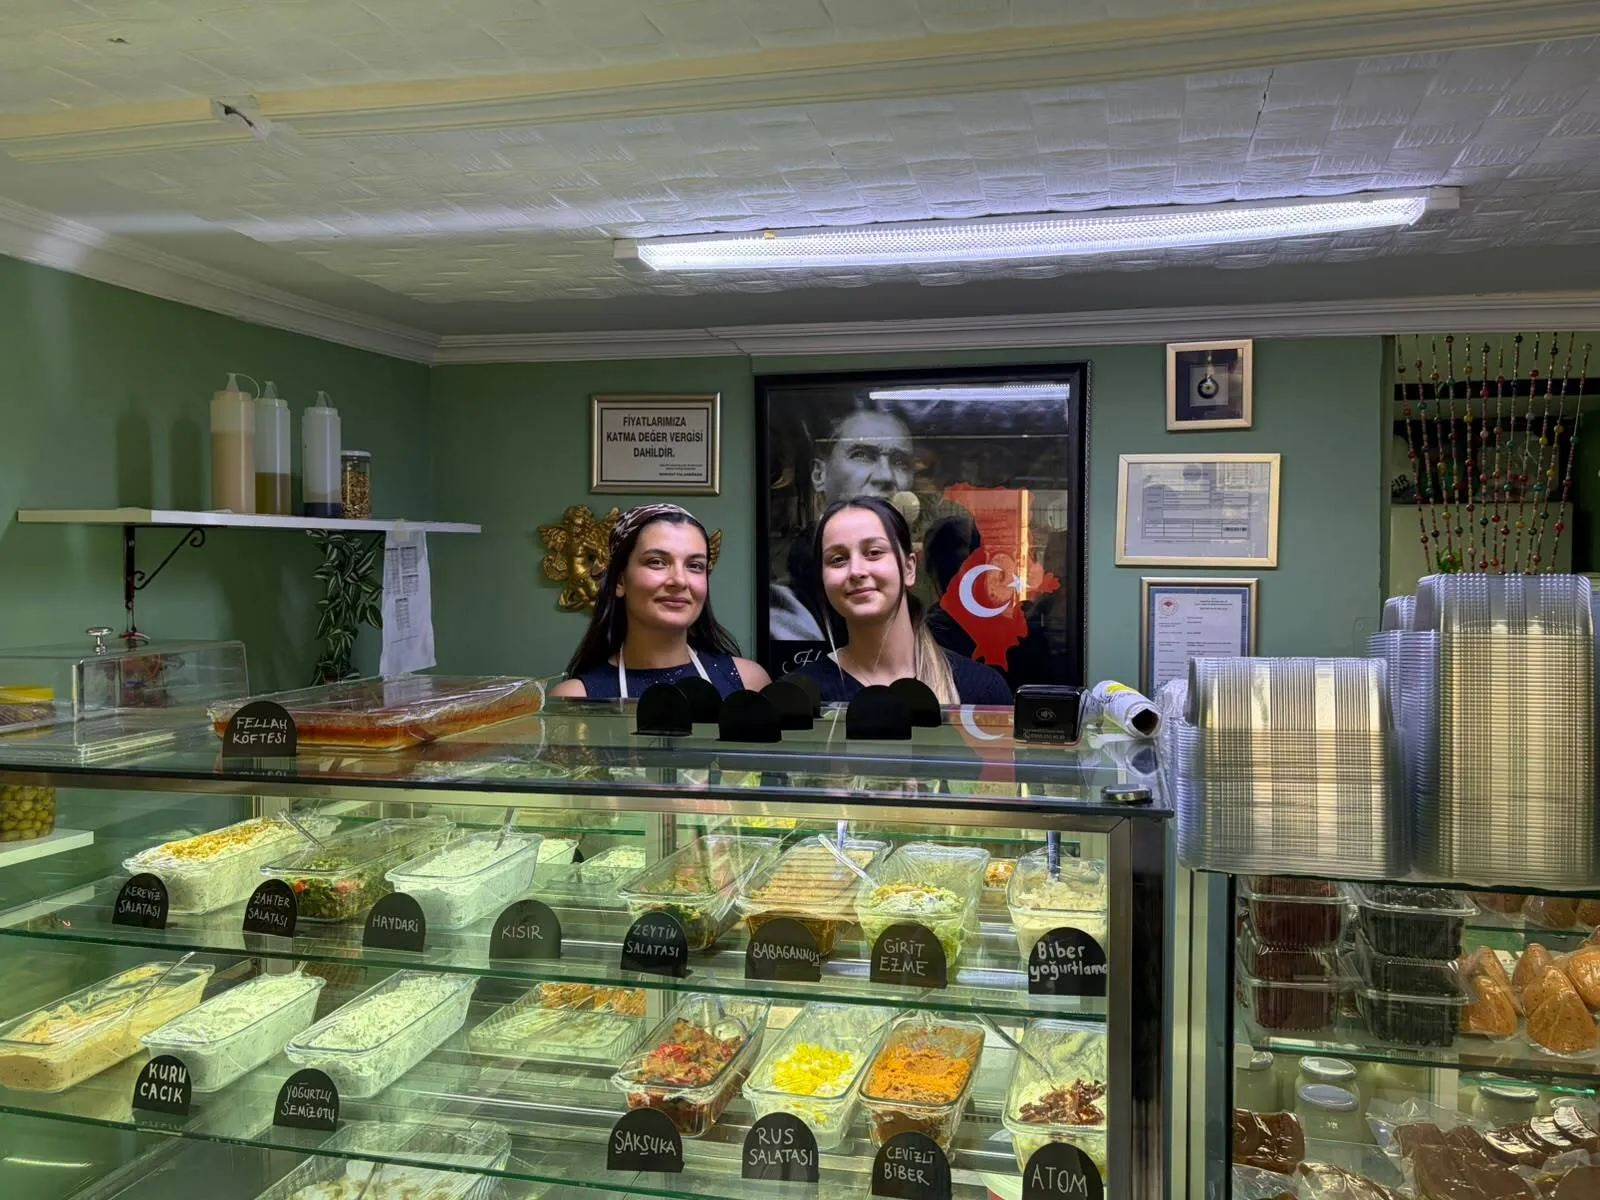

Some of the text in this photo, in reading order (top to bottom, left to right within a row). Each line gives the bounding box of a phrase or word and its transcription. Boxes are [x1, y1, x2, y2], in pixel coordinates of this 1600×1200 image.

[623, 414, 686, 427] FİYATLARIMIZA
[606, 429, 703, 443] KATMA DEĞER VERGİSİ
[633, 444, 675, 458] DAHİLDİR.
[236, 716, 287, 730] FELLAH
[118, 900, 161, 919] SALATASI
[253, 892, 291, 909] ZAHTER
[247, 908, 288, 928] SALATASI
[501, 924, 544, 940] KISIR
[633, 924, 678, 940] ZEYTİN
[626, 942, 680, 958] SALATASI
[883, 937, 926, 957] GİRİT
[1037, 940, 1086, 960] Biber
[879, 956, 928, 976] EZME
[149, 1062, 188, 1085] KURU
[140, 1082, 184, 1104] CACIK
[756, 1127, 795, 1145] RUS
[749, 1149, 814, 1167] SALATASI
[886, 1146, 936, 1165] CEVİZLİ
[884, 1162, 931, 1187] BİBER
[1032, 1163, 1089, 1197] ATOM
